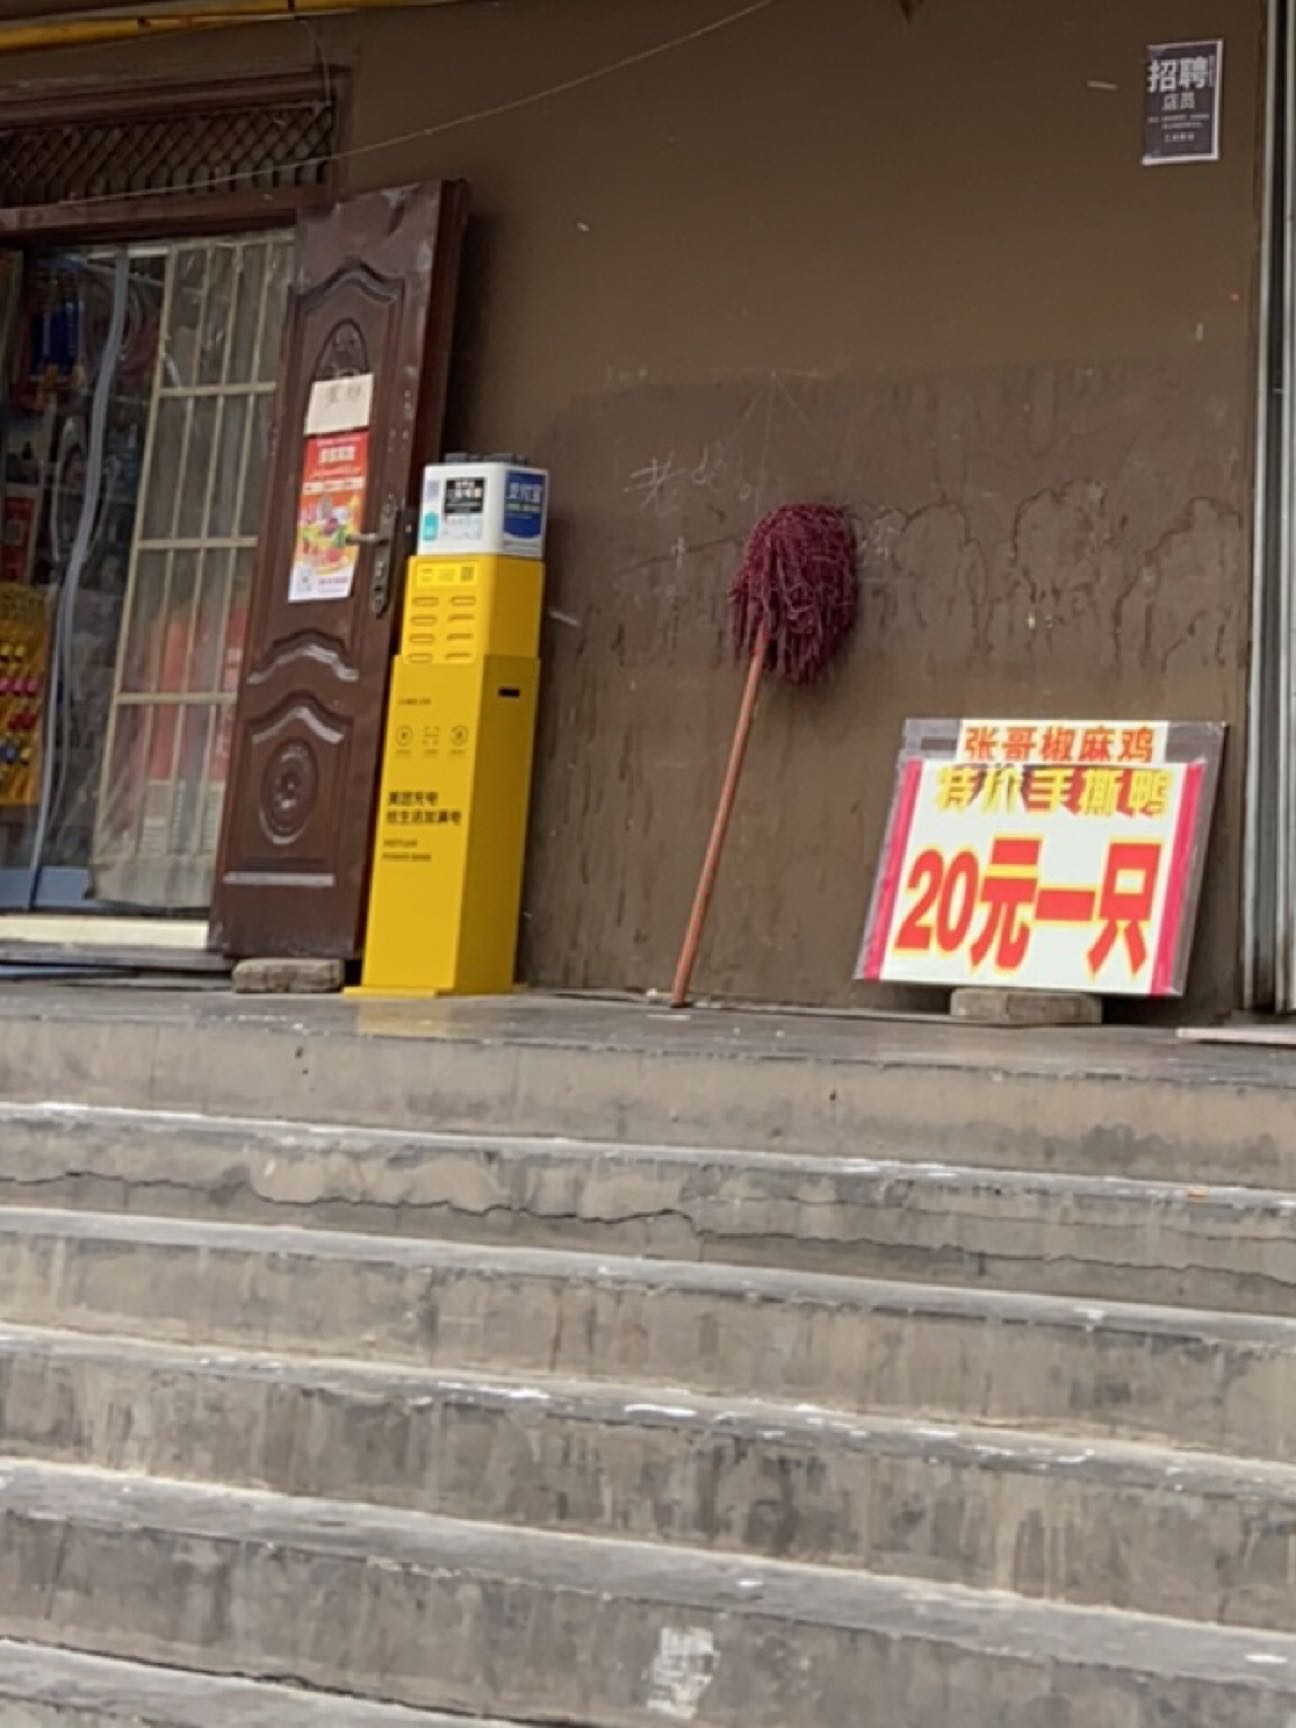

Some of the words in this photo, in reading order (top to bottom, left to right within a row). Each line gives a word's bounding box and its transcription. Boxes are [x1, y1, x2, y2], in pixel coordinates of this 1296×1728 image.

[963, 725, 1156, 763] 张哥椒麻鸡
[893, 835, 1163, 978] 20元一只
